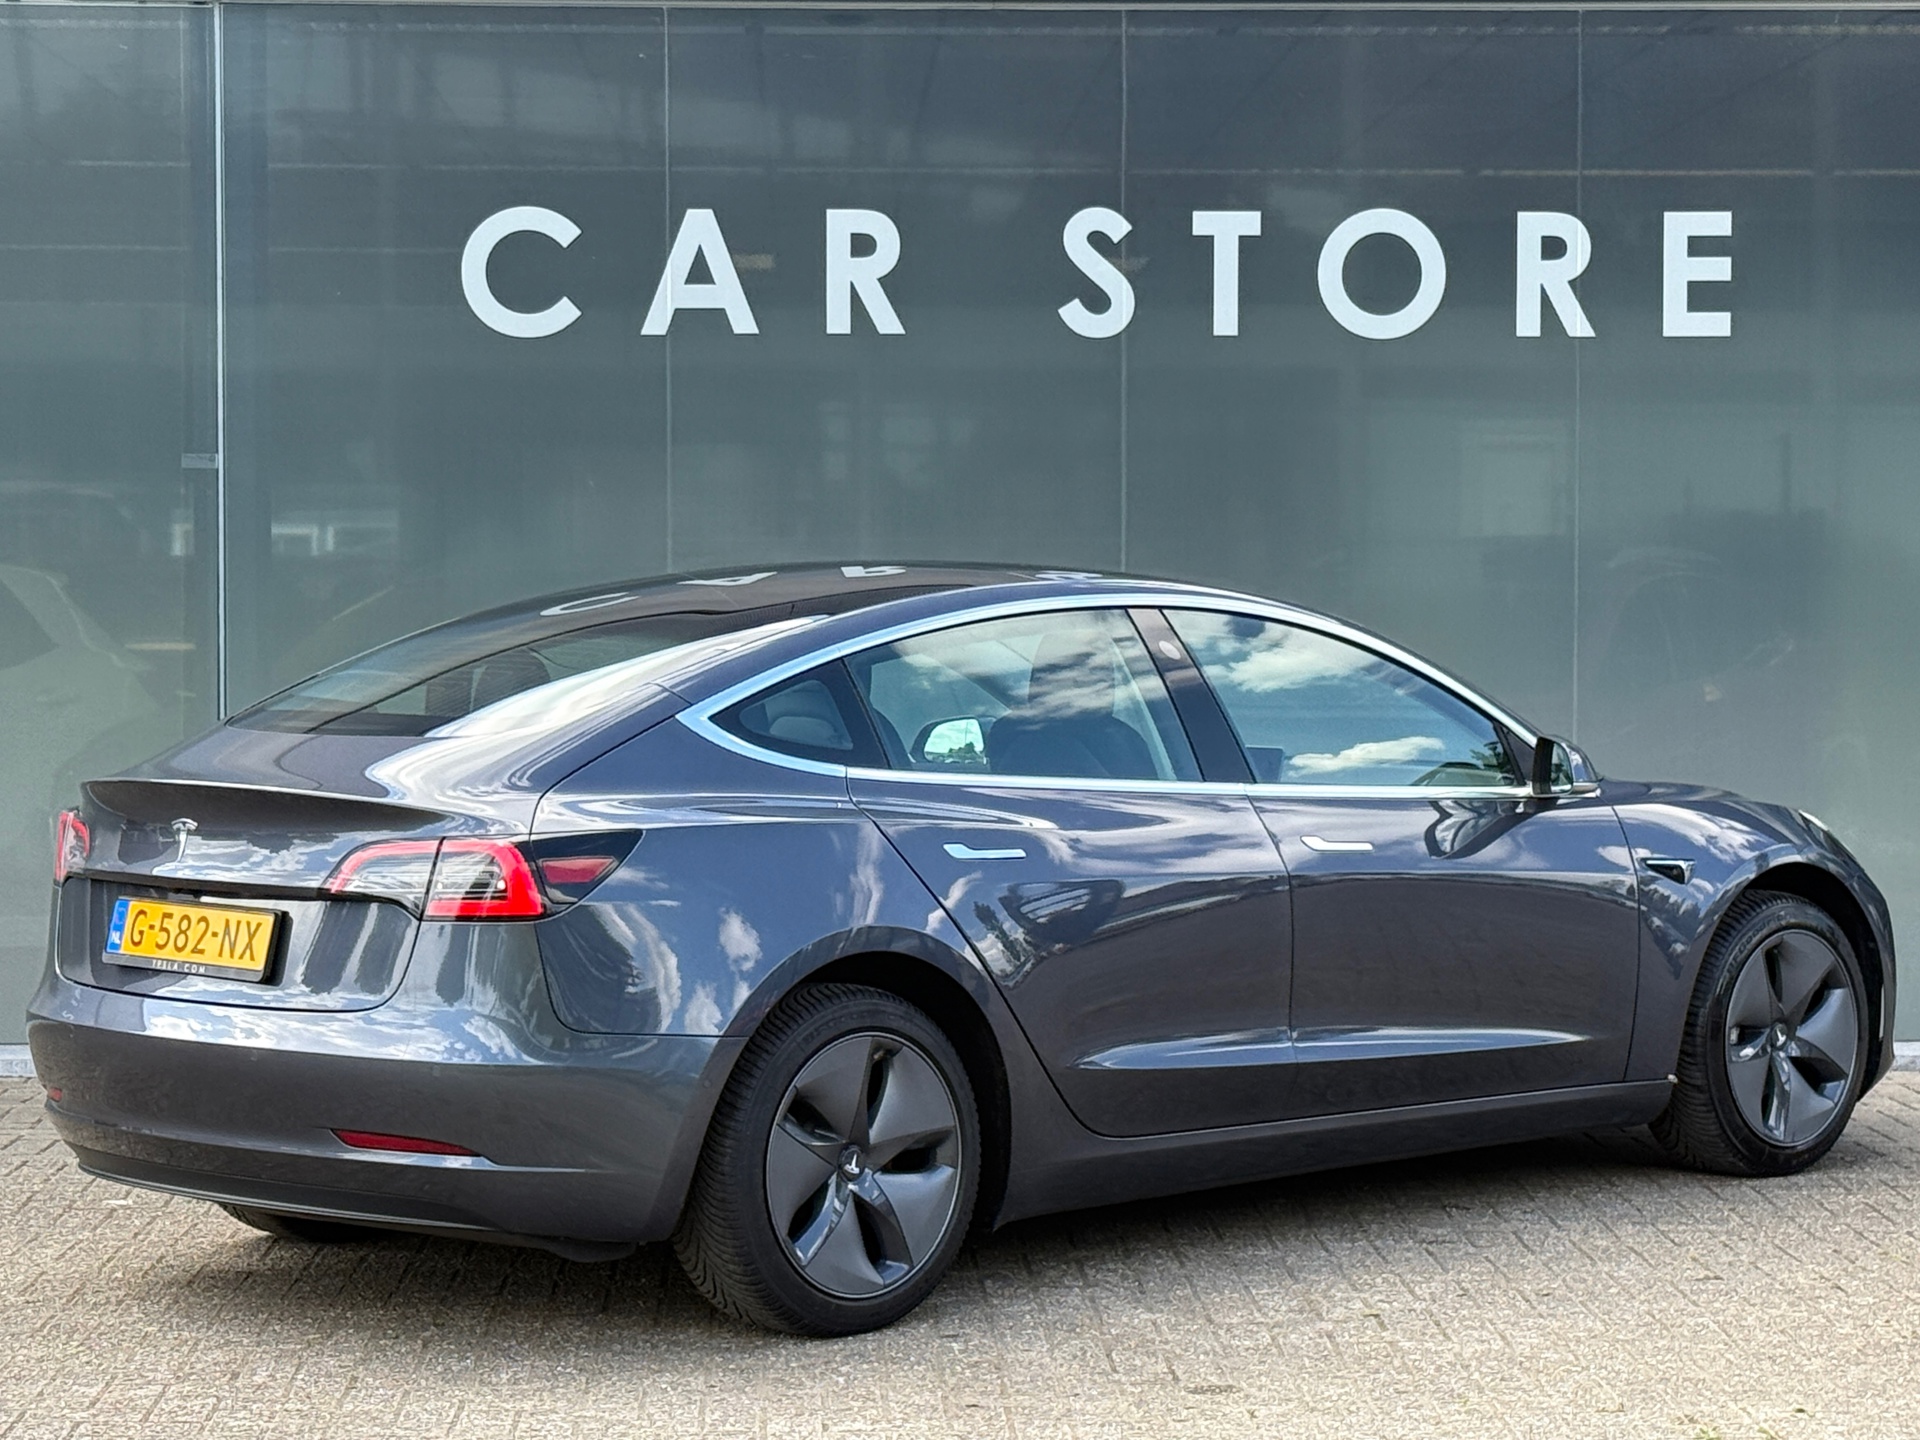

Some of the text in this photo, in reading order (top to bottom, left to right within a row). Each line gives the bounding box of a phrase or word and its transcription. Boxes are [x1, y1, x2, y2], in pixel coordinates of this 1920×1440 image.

[460, 206, 1733, 340] CAR STORE
[130, 908, 263, 962] G-582-NX
